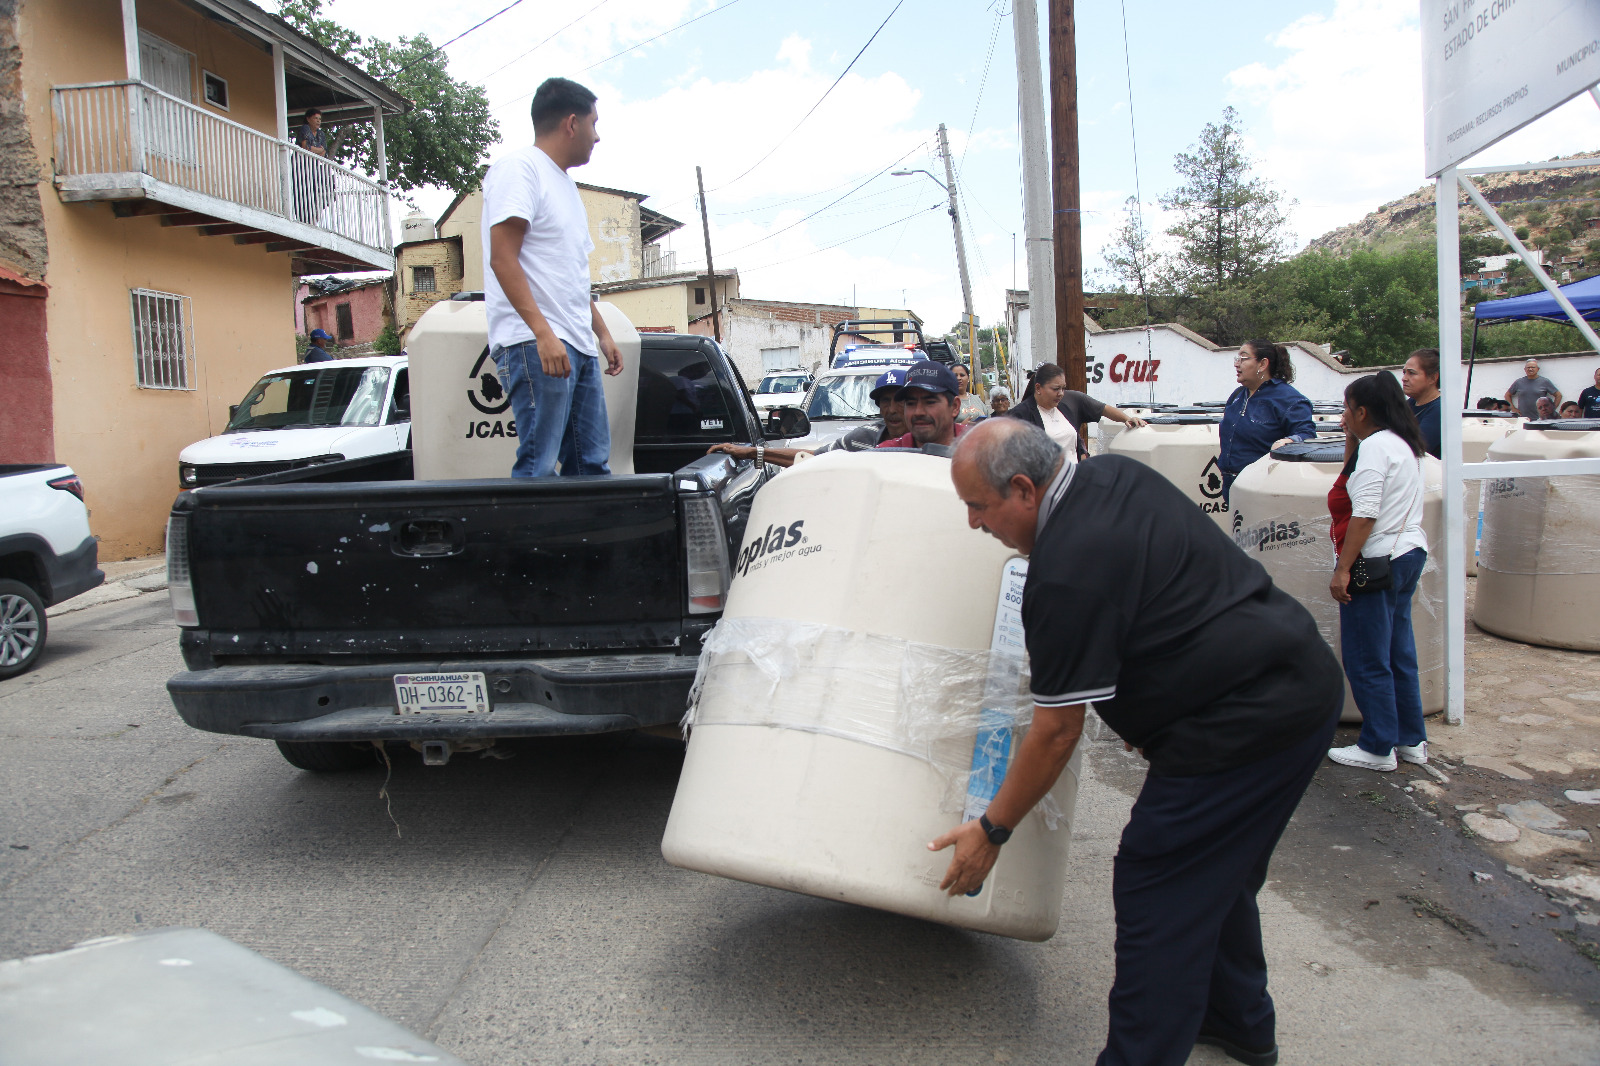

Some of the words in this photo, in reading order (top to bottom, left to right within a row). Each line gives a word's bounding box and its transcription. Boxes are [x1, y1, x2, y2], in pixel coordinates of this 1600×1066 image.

[1443, 2, 1459, 32] SAN
[1444, 22, 1474, 61] ESTADO
[1476, 8, 1489, 33] DE
[1446, 120, 1476, 145] PROGRAMA:
[1475, 101, 1502, 128] RECURSOS
[1503, 84, 1529, 110] PROPIOS
[886, 371, 897, 384] LA
[1109, 353, 1160, 383] Cruz
[465, 421, 519, 438] JCAS
[732, 520, 804, 578] oplas
[763, 558, 769, 568] y
[770, 549, 796, 562] mejor
[798, 544, 822, 557] agua
[1281, 540, 1298, 549] mejor
[1005, 592, 1022, 605] 800
[399, 684, 485, 705] DH-0362-A
